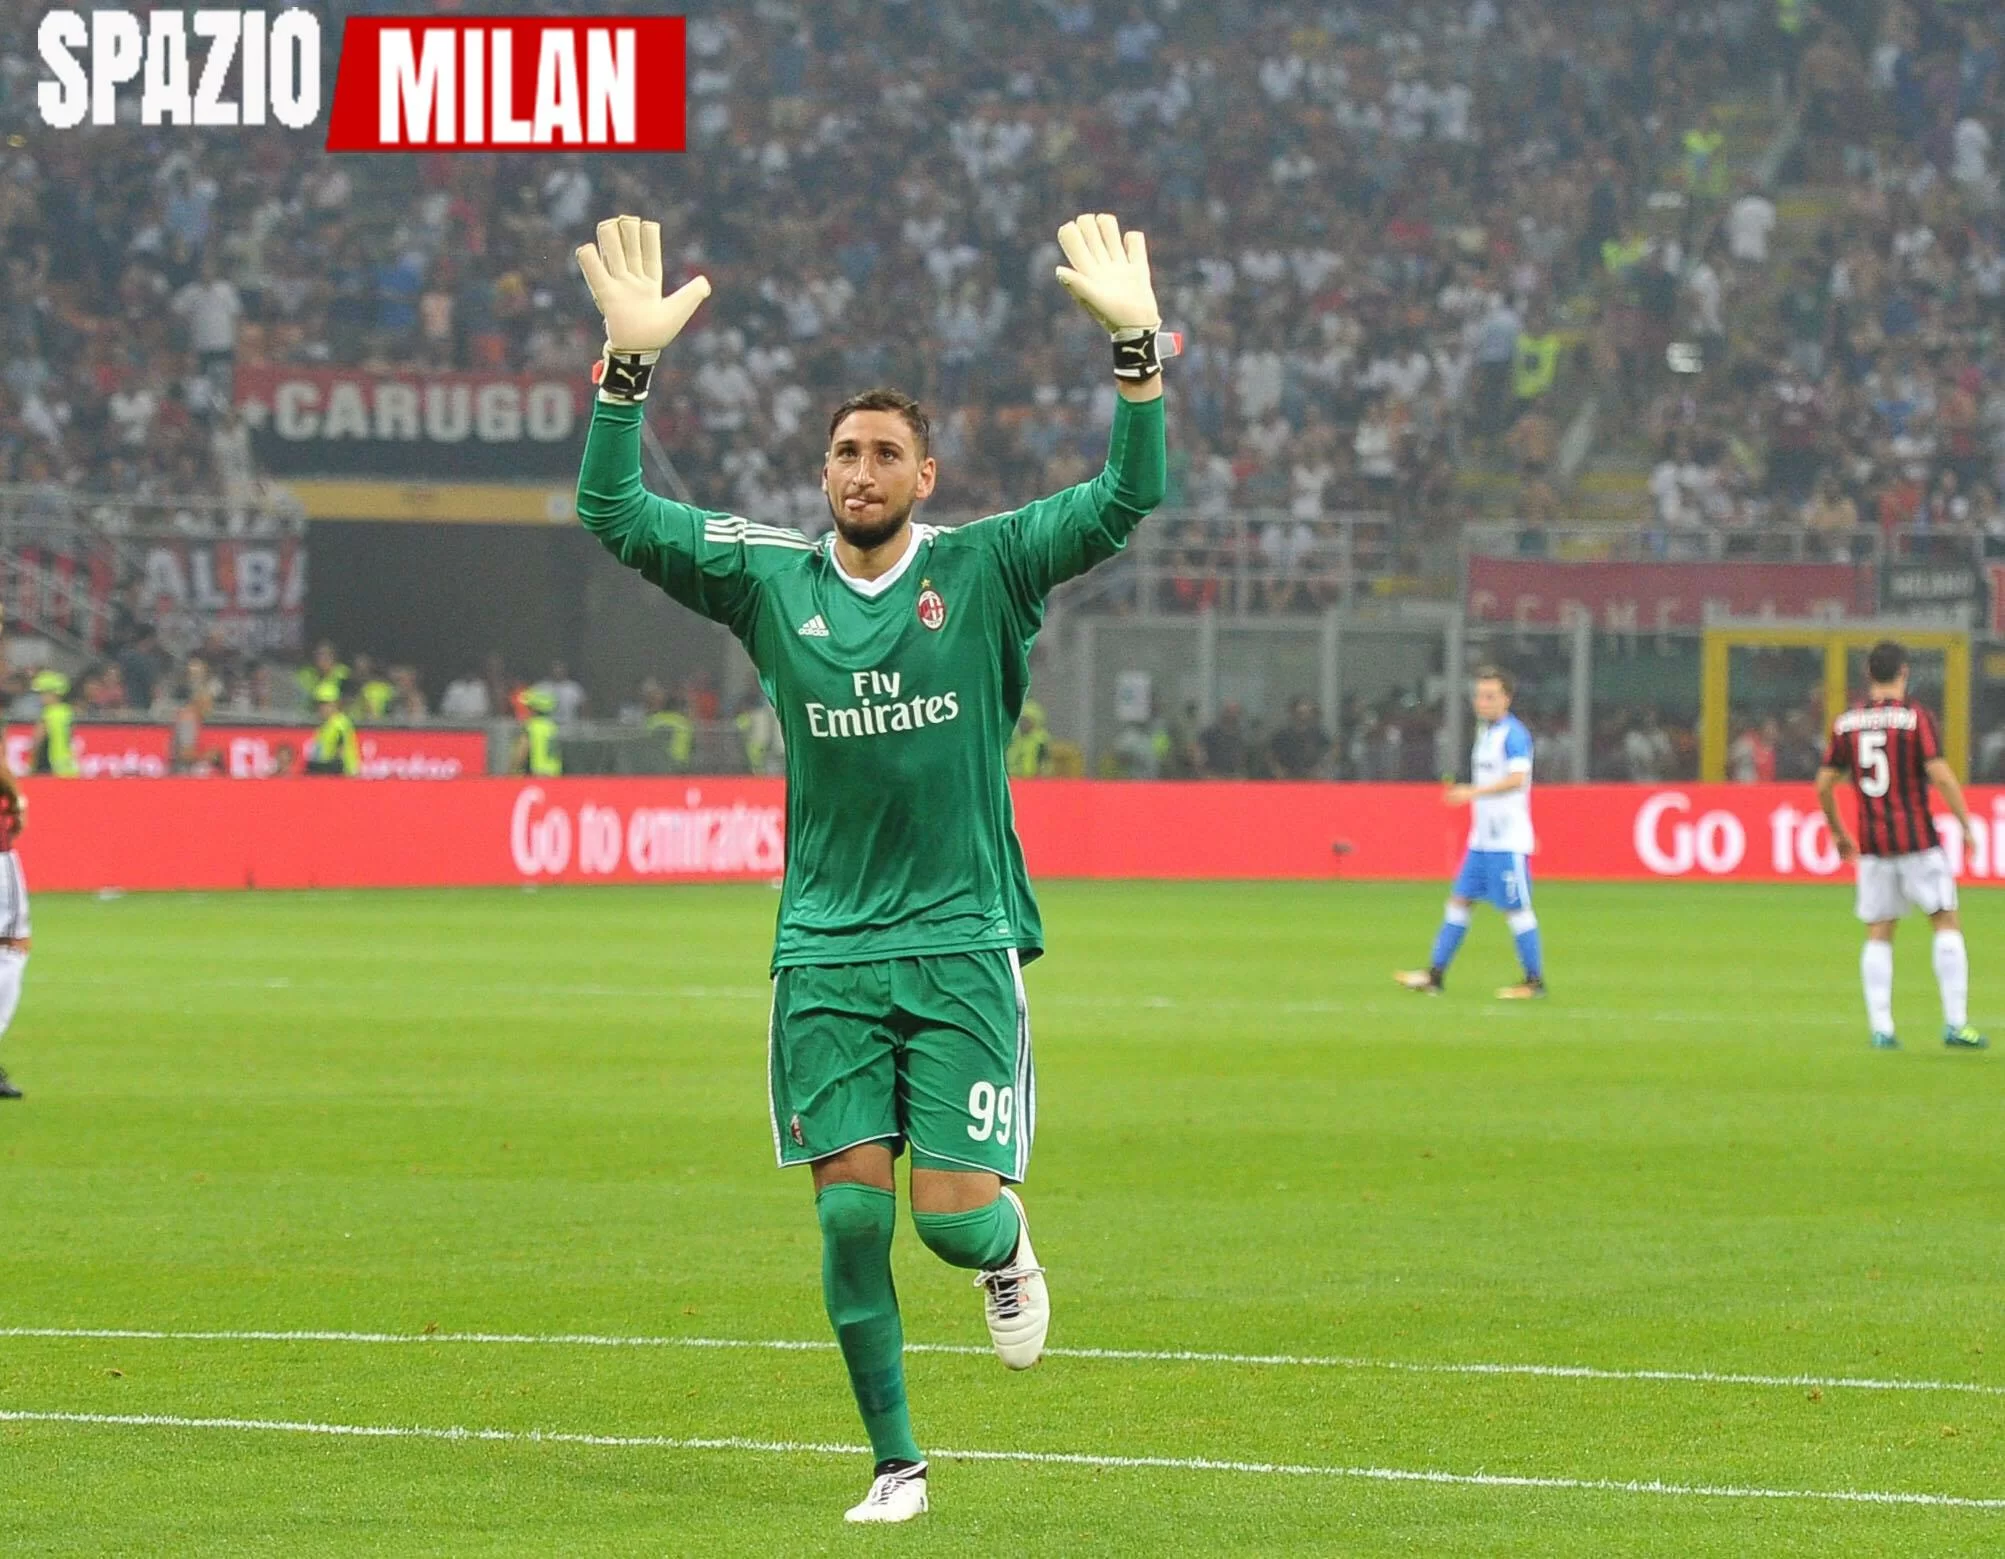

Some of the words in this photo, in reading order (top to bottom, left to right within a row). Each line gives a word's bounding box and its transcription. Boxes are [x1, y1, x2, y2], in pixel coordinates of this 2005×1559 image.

[275, 380, 577, 442] CARUGO
[805, 691, 959, 738] Emirates
[852, 671, 900, 698] Fly
[1858, 729, 1891, 798] 5
[511, 785, 572, 875] Go
[579, 802, 622, 874] to
[627, 786, 786, 874] emirates
[1634, 791, 1746, 875] Go
[1771, 801, 1842, 875] to
[967, 1081, 1014, 1146] 99
